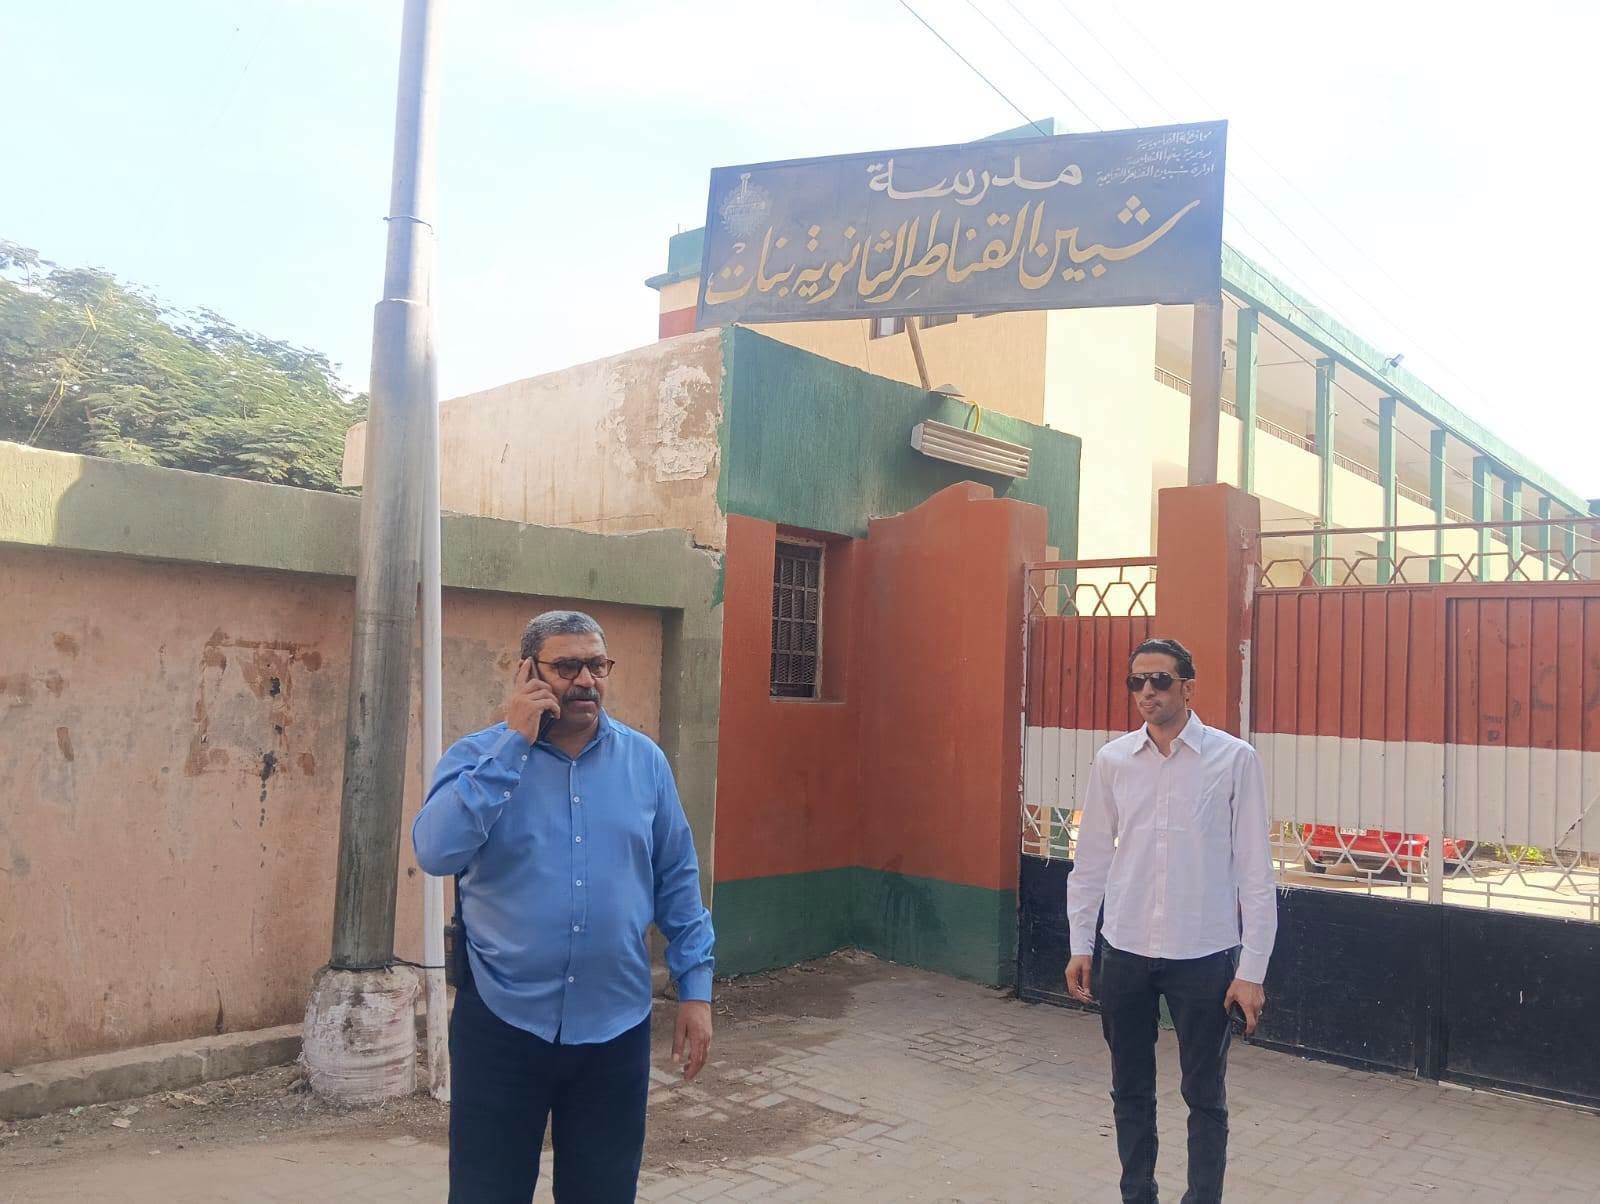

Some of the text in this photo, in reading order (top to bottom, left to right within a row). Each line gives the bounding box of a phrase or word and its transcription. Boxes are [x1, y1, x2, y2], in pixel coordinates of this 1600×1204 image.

[867, 156, 1083, 206] مدرسة
[704, 195, 1200, 305] شبين القناطر الثانوية بنات
